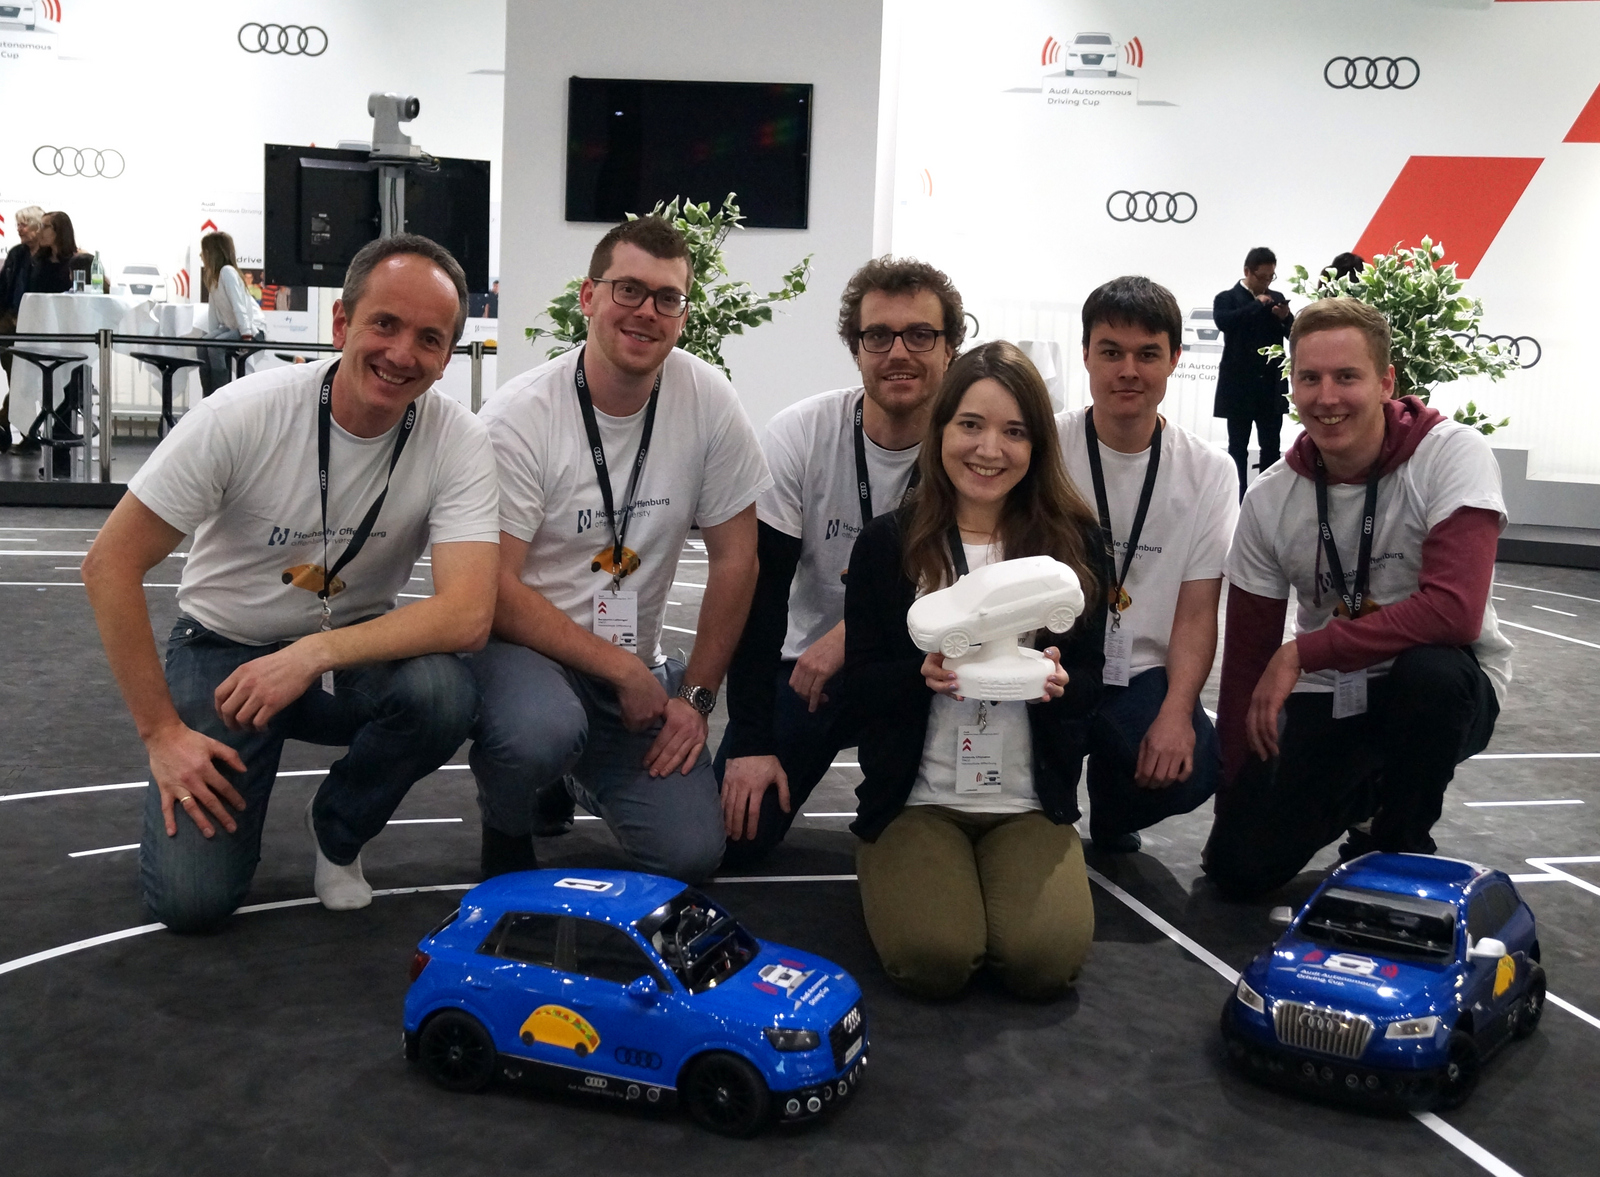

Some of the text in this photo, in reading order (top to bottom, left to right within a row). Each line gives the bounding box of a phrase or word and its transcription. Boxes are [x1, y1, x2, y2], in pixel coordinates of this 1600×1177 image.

[0, 51, 20, 59] Cup
[1048, 87, 1132, 96] Audi Autonomous
[1047, 98, 1100, 107] Driving Cup
[236, 256, 263, 264] drive
[1170, 372, 1217, 381] riving Cup
